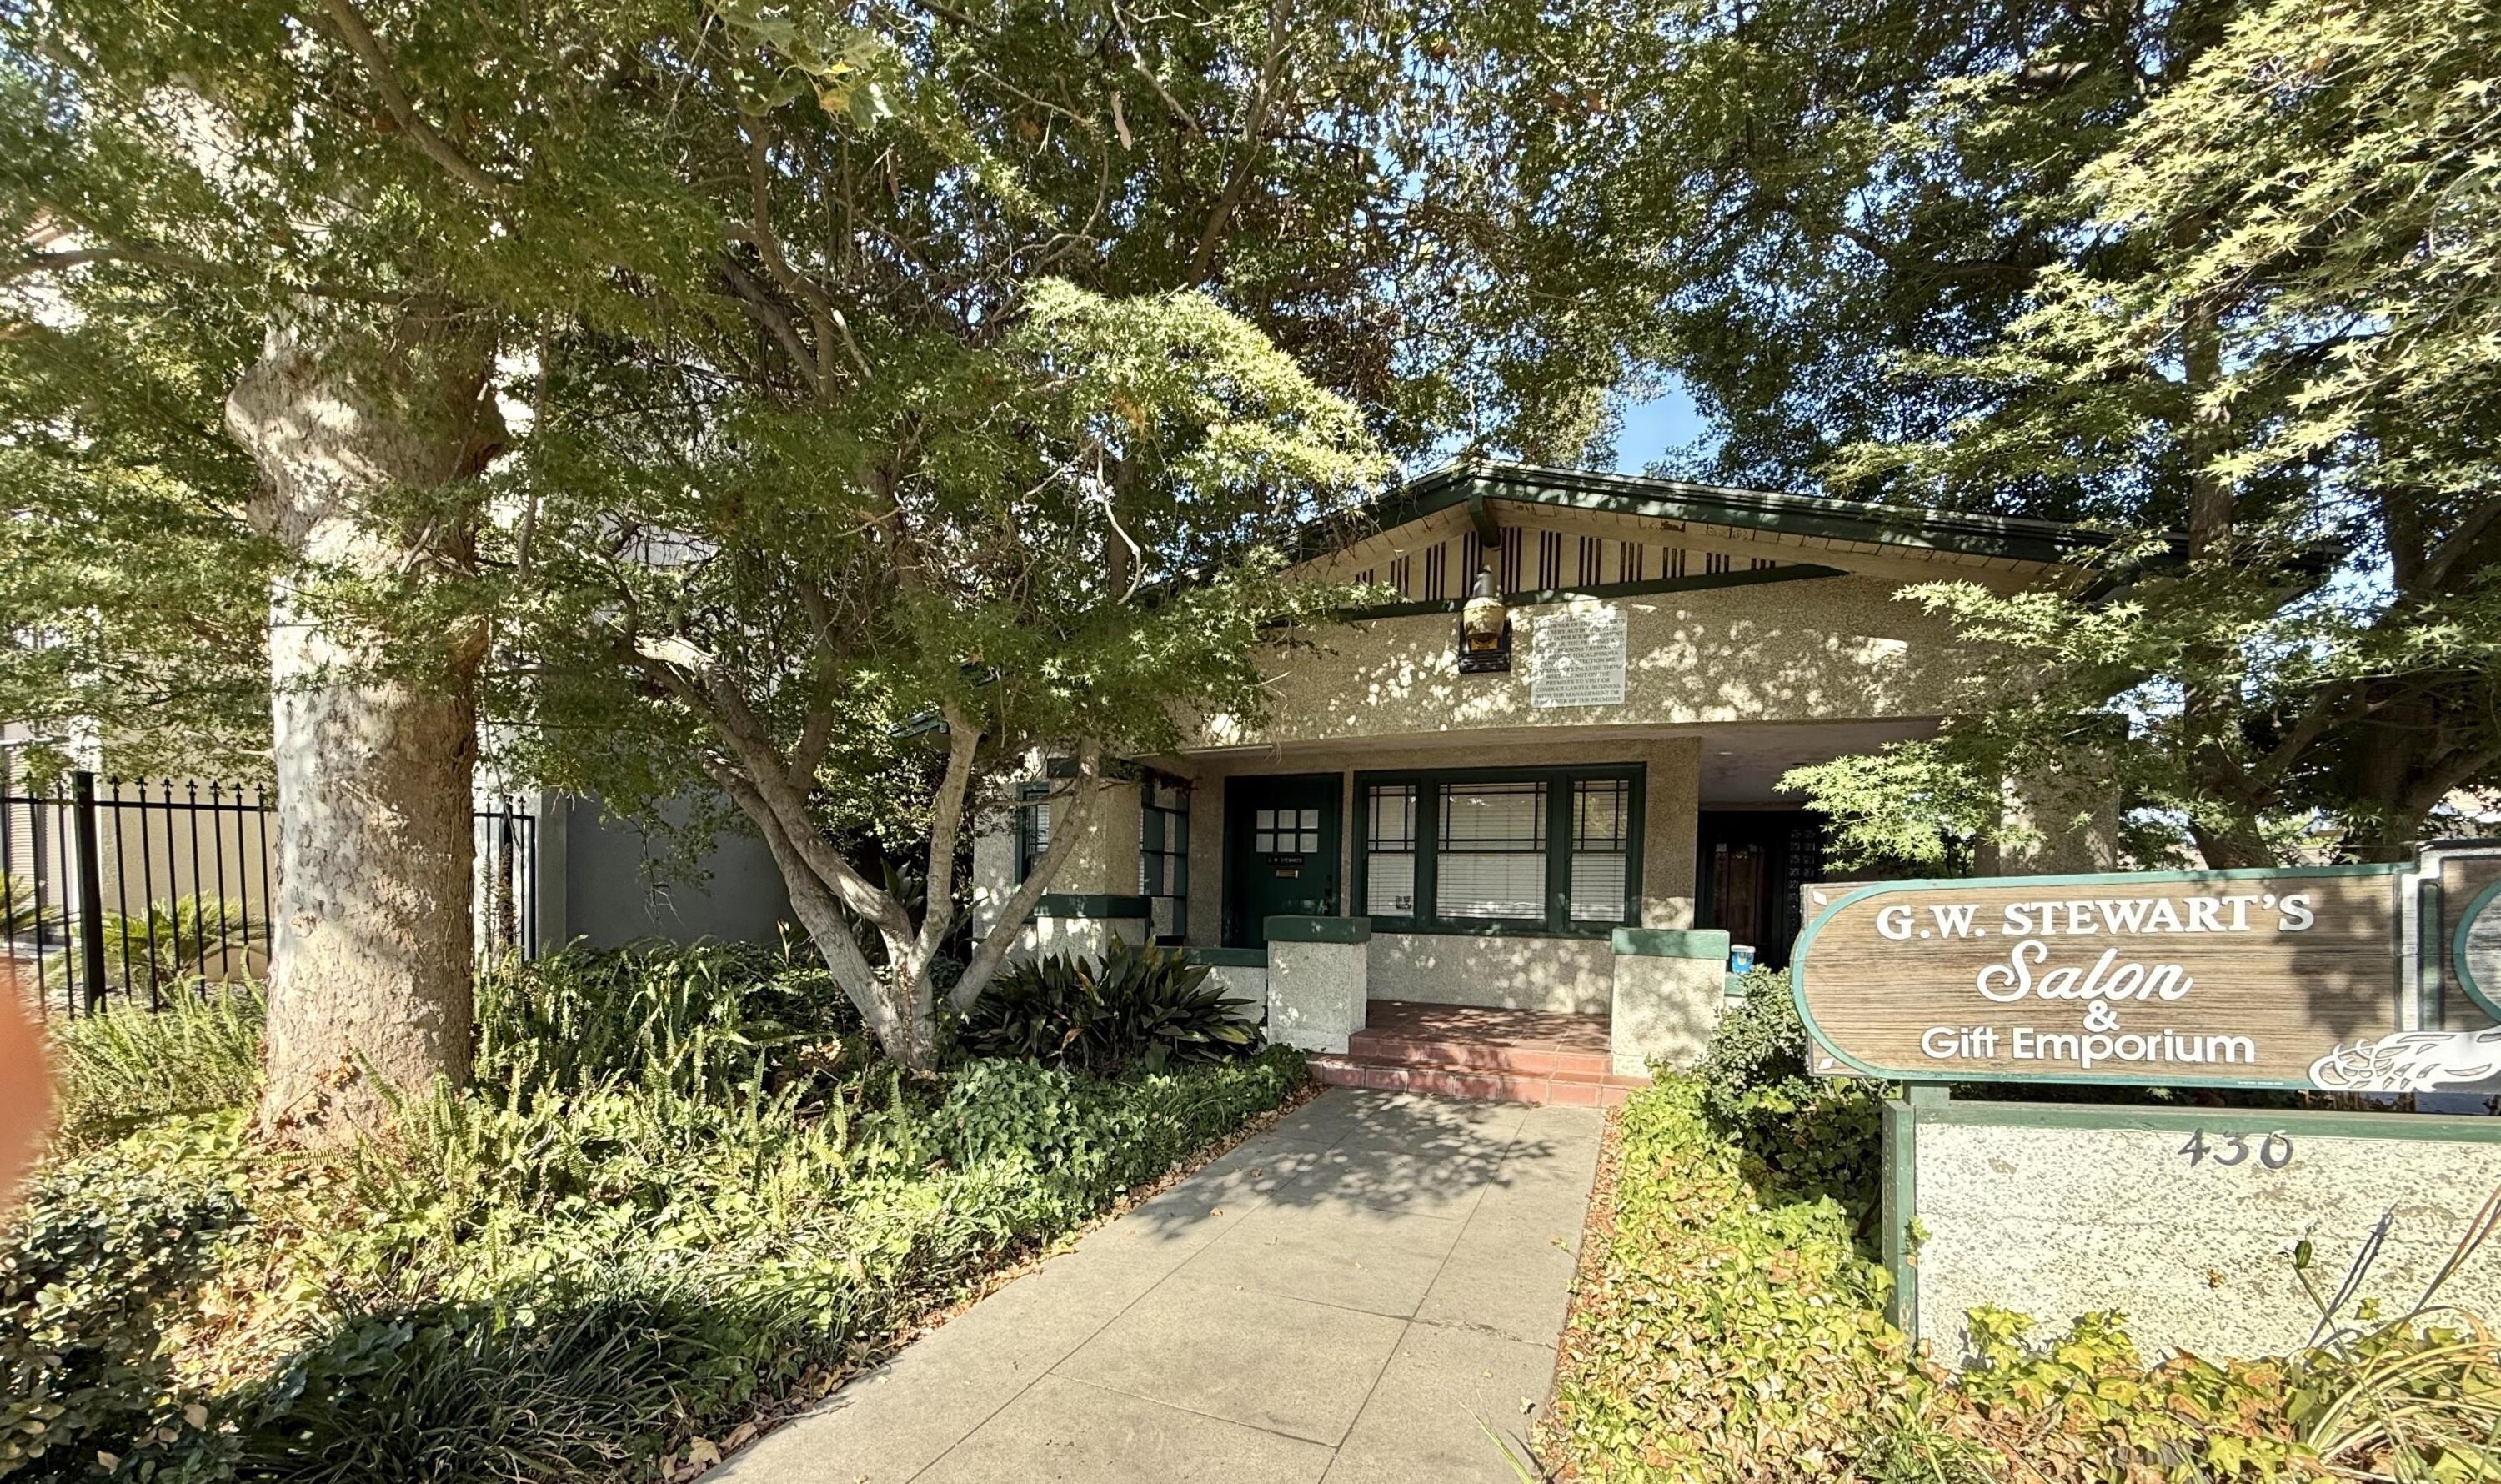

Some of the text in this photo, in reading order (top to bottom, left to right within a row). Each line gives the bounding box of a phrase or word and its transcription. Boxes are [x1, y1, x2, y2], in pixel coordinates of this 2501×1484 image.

[1876, 894, 2315, 940] G.W. STEWART'S
[1976, 939, 2195, 1002] Salon
[2082, 1000, 2121, 1033] &
[1920, 1025, 2255, 1069] Gift Emporium
